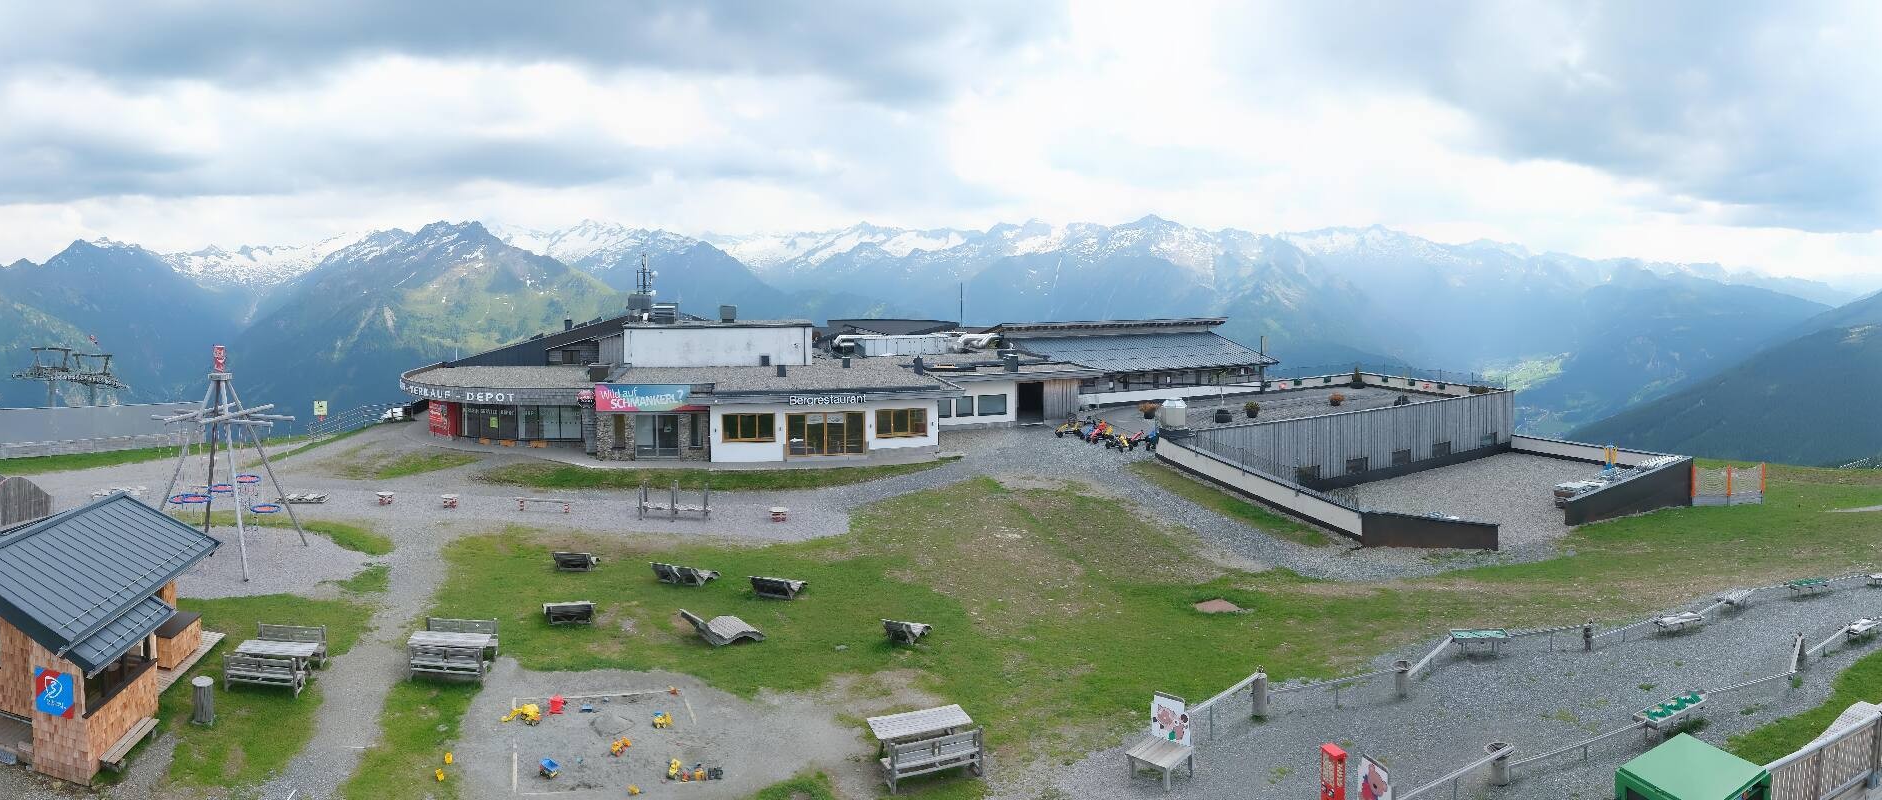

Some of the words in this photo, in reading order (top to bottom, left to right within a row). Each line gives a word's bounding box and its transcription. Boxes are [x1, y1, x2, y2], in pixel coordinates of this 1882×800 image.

[466, 392, 515, 402] DEPOT
[600, 389, 621, 400] Wild
[622, 386, 637, 398] auf
[789, 394, 867, 406] Bergrestaurant
